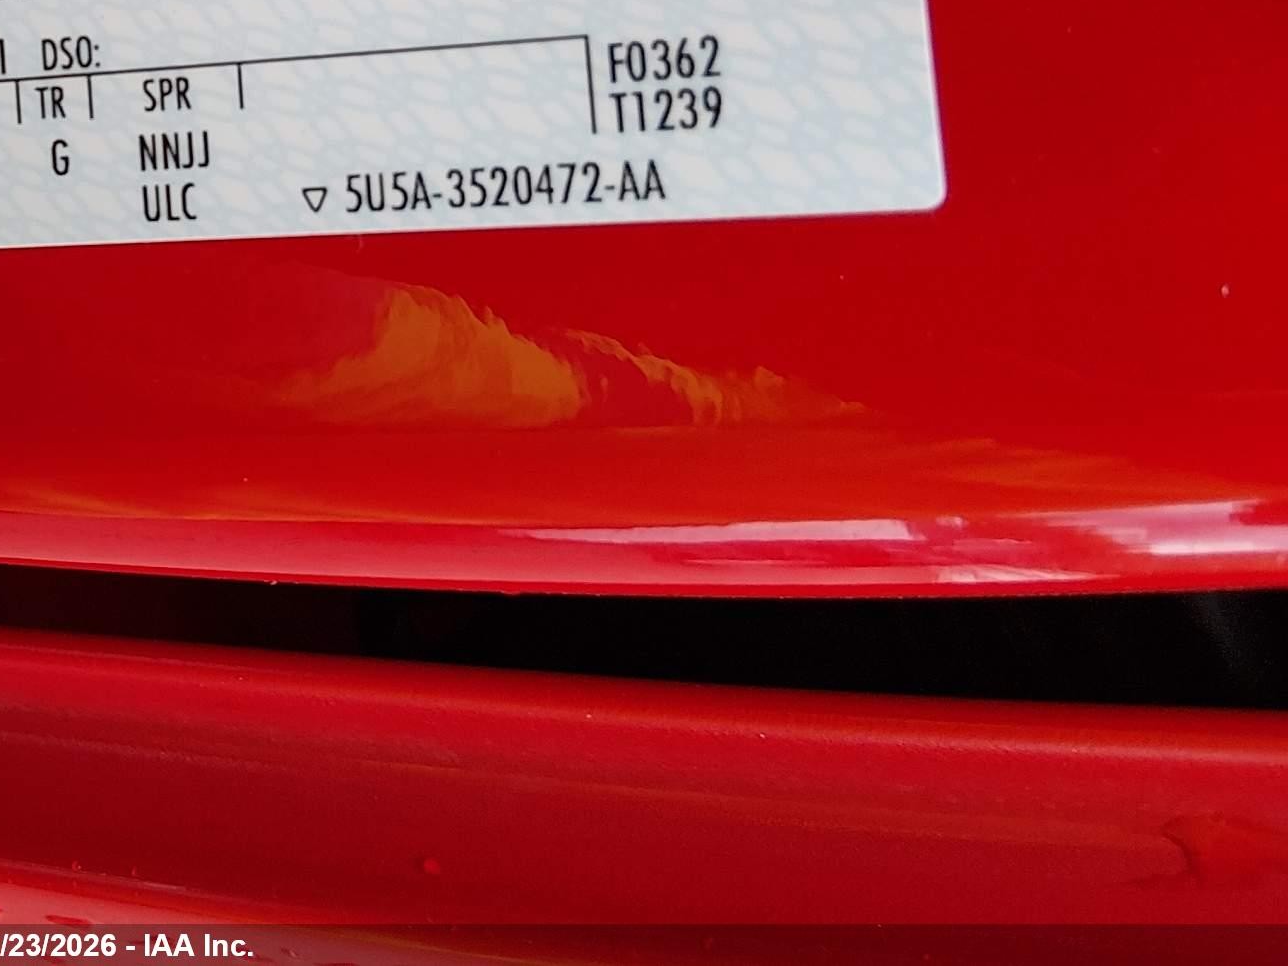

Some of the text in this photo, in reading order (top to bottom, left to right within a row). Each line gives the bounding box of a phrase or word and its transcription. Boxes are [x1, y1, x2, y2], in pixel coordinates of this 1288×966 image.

[41, 35, 101, 72] DSO:
[34, 85, 67, 120] TR
[142, 76, 192, 113] SPR
[609, 85, 723, 134] T1239
[50, 138, 70, 177] G
[138, 130, 210, 172] NNJJ
[141, 182, 198, 223] ULC
[346, 159, 666, 214] 5U5A-3520472-AA
